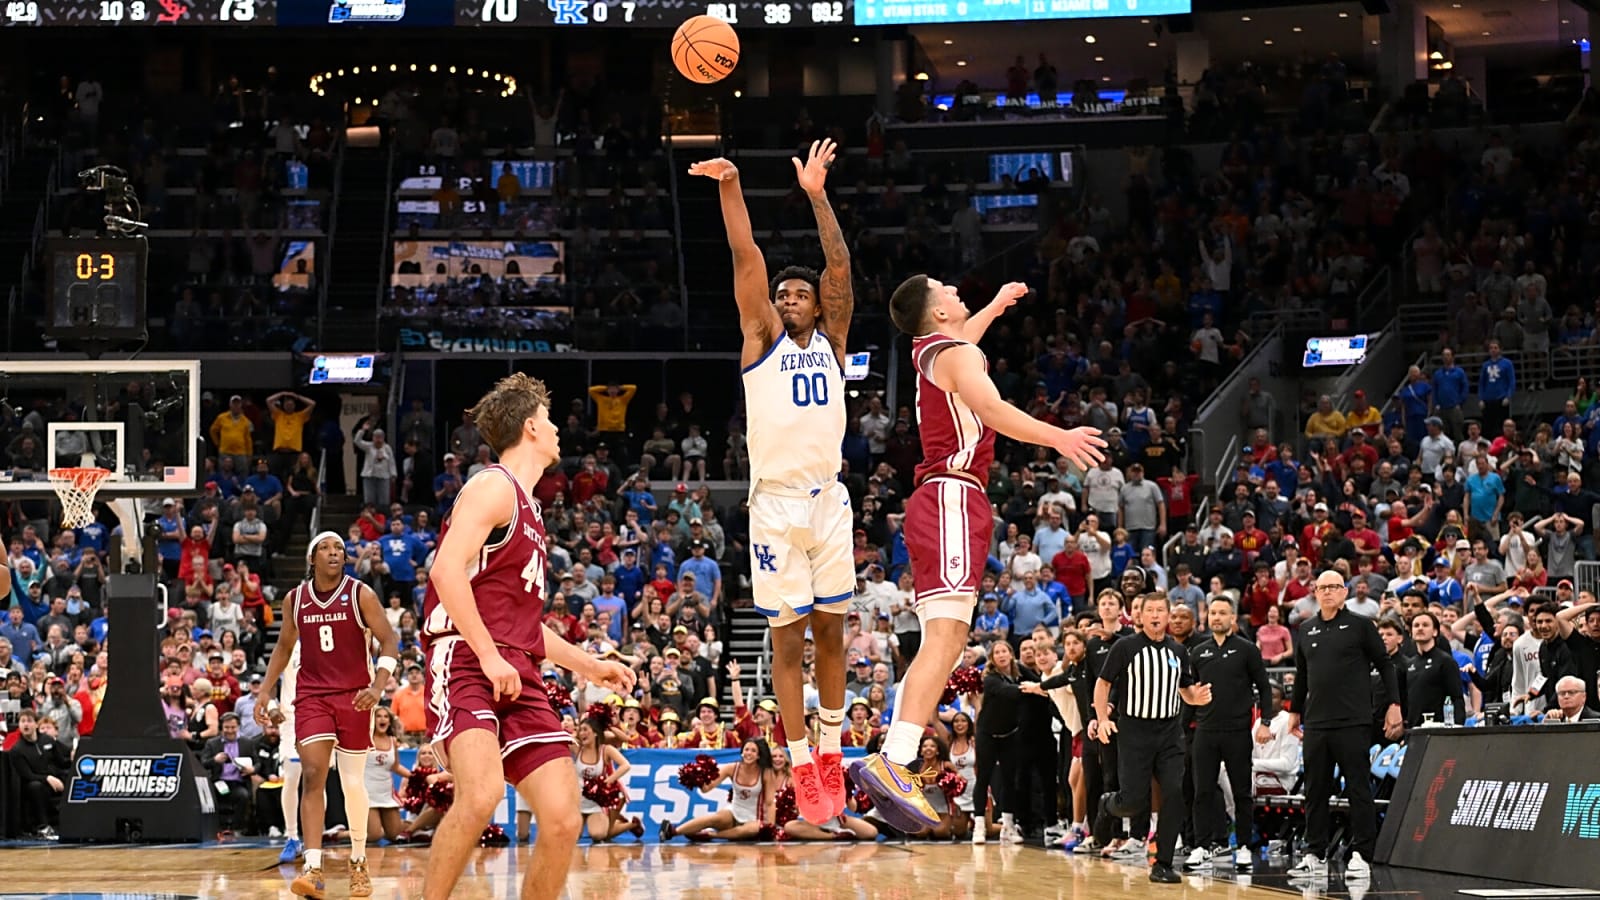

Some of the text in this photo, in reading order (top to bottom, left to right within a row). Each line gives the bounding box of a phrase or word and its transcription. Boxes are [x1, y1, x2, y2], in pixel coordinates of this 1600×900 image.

[100, 1, 145, 20] 10 3
[220, 0, 254, 21] 73
[482, 0, 518, 22] 70
[593, 2, 636, 22] 0 7
[764, 4, 791, 23] 36
[883, 5, 912, 17] UTAH
[913, 3, 947, 16] STATE
[1051, 0, 1090, 11] MIAMI
[77, 254, 115, 280] 0.3
[792, 373, 829, 407] 00
[520, 549, 546, 600] 44
[303, 611, 347, 624] SANTA CLARA
[319, 625, 335, 652] 8
[95, 759, 152, 777] MARCH
[100, 776, 177, 793] MADNESS
[1450, 779, 1503, 829] SANTA
[1493, 781, 1550, 831] CLARA
